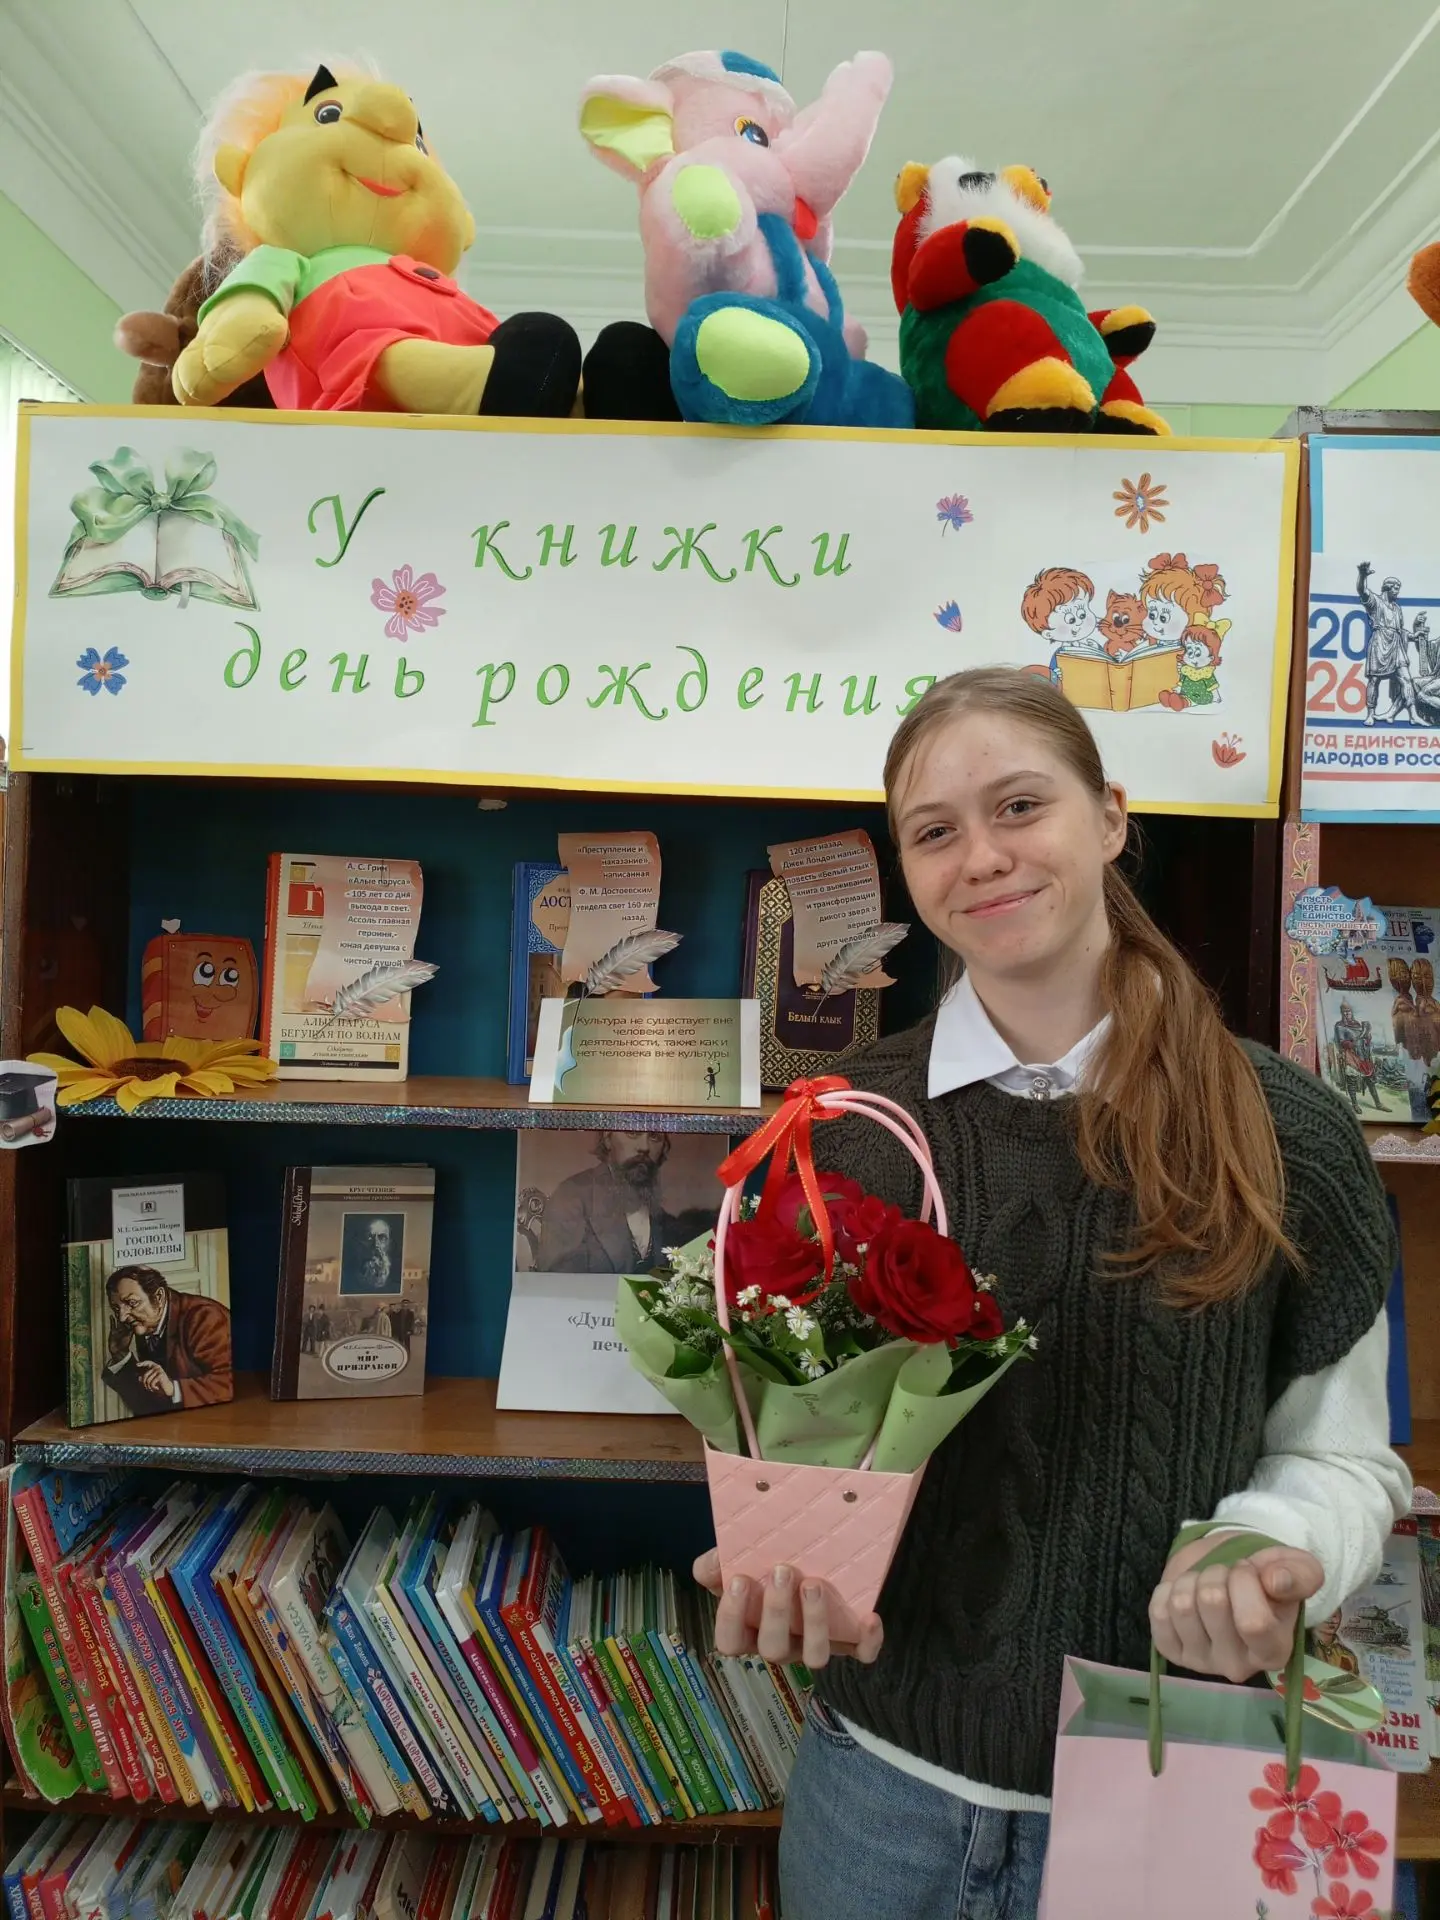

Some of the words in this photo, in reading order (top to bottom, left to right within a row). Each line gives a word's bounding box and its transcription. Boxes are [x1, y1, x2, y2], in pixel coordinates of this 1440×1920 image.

[308, 487, 386, 568] У
[471, 518, 851, 587] книжки
[1307, 607, 1371, 660] 20
[224, 621, 426, 699] день
[472, 645, 937, 727] рождения
[1306, 660, 1366, 714] 26
[1305, 734, 1337, 749] ГОД
[1344, 735, 1440, 750] ЕДИНСТВА
[1304, 752, 1389, 767] НАРОДОВ
[578, 846, 637, 854] «Преступление
[789, 847, 803, 855] 120
[819, 840, 843, 850] назад
[347, 863, 356, 871] А.
[358, 863, 365, 871] С.
[367, 863, 387, 873] Грин
[782, 859, 804, 870] Джек
[806, 855, 836, 864] Лондон
[348, 877, 376, 885] «Алые
[378, 878, 410, 887] паруса»
[786, 874, 816, 885] повесть
[818, 867, 847, 878] «Белый
[796, 887, 818, 896] книга
[826, 877, 873, 891] выживании
[395, 891, 410, 900] дня
[540, 895, 571, 909] ДОСТ
[813, 892, 876, 909] трансформации
[1302, 896, 1332, 904] ПУСТЬ
[351, 903, 381, 912] выхода
[576, 903, 607, 912] увидела
[608, 902, 625, 910] свет
[628, 901, 641, 909] 160
[1302, 904, 1343, 912] КРЕПНЕТ
[348, 916, 376, 925] Ассоль
[819, 913, 846, 923] дикого
[848, 909, 870, 918] зверя
[847, 918, 879, 929] верного
[1325, 922, 1379, 930] ПРОЦВЕТАЕТ
[340, 942, 362, 951] юная
[363, 943, 400, 952] девушка
[816, 940, 838, 949] друга
[344, 957, 372, 965] чистой
[337, 1018, 380, 1029] ПАРУСА
[576, 1016, 627, 1027] Культура
[647, 1017, 710, 1028] существует
[337, 1030, 353, 1039] ПО
[356, 1031, 401, 1042] ВОЛНАМ
[613, 1028, 665, 1037] человека
[677, 1028, 696, 1037] его
[578, 1039, 661, 1049] деятельности,
[664, 1039, 697, 1047] также
[699, 1039, 718, 1047] как
[721, 1039, 728, 1047] и
[576, 1050, 596, 1058] нет
[599, 1049, 651, 1058] человека
[655, 1050, 676, 1058] вне
[678, 1049, 730, 1060] культуры
[126, 1233, 173, 1245] ГОСПОДА
[117, 1244, 181, 1258] ГОЛОВЛЕВЫ
[337, 1363, 397, 1371] ПРИЗРАКОВ
[13, 1501, 46, 1565] малышей
[104, 1570, 138, 1621] СПАСАЛИ
[43, 1584, 73, 1642] сказки
[127, 1619, 156, 1662] СКАЗКУ
[185, 1603, 224, 1669] ПОРОСЕНКА
[516, 1628, 535, 1651] МОРЯ
[160, 1646, 179, 1679] истории
[218, 1670, 234, 1693] ТРИ
[525, 1650, 565, 1707] КОШМАРСКОГО
[541, 1648, 585, 1715] МОЙДОДЫР
[408, 1670, 431, 1704] РАССКАЗЫ
[465, 1651, 523, 1739] Цветик-семицветик
[554, 1705, 577, 1737] ПИРАТЫ
[626, 1681, 649, 1719] ТЕРЕМОК
[643, 1720, 663, 1752] СКАЗОК
[84, 1702, 110, 1752] МАРШАК
[170, 1716, 189, 1741] КАК
[626, 1714, 652, 1755] СКАЗКИ
[372, 1682, 406, 1729] КОРОЛЕВА
[403, 1740, 441, 1795] КОРОЛЕВСТВА
[477, 1713, 506, 1760] Корней
[688, 1757, 708, 1786] НОСОВ
